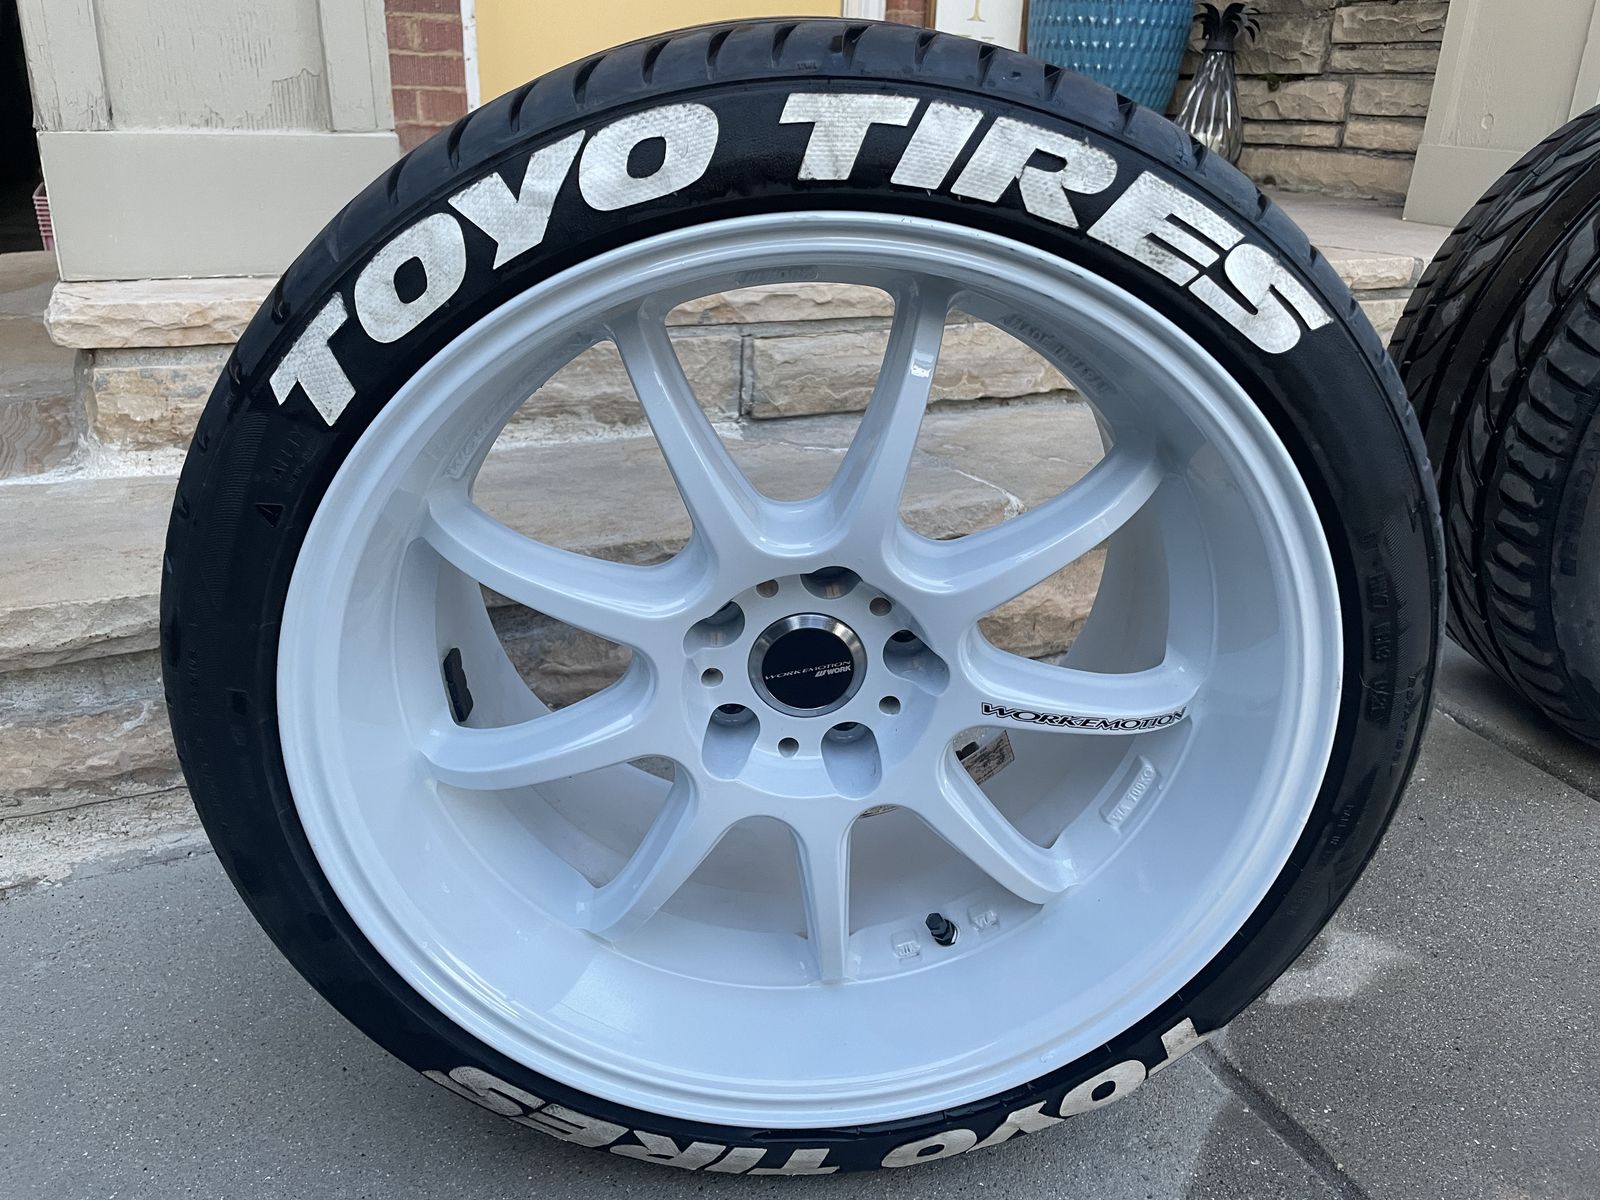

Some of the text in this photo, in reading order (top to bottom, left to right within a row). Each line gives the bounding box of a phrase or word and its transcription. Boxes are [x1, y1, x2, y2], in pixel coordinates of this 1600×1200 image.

[269, 93, 1334, 426] TOYO TIRES
[421, 1017, 1223, 1176] TOYO TIRES
